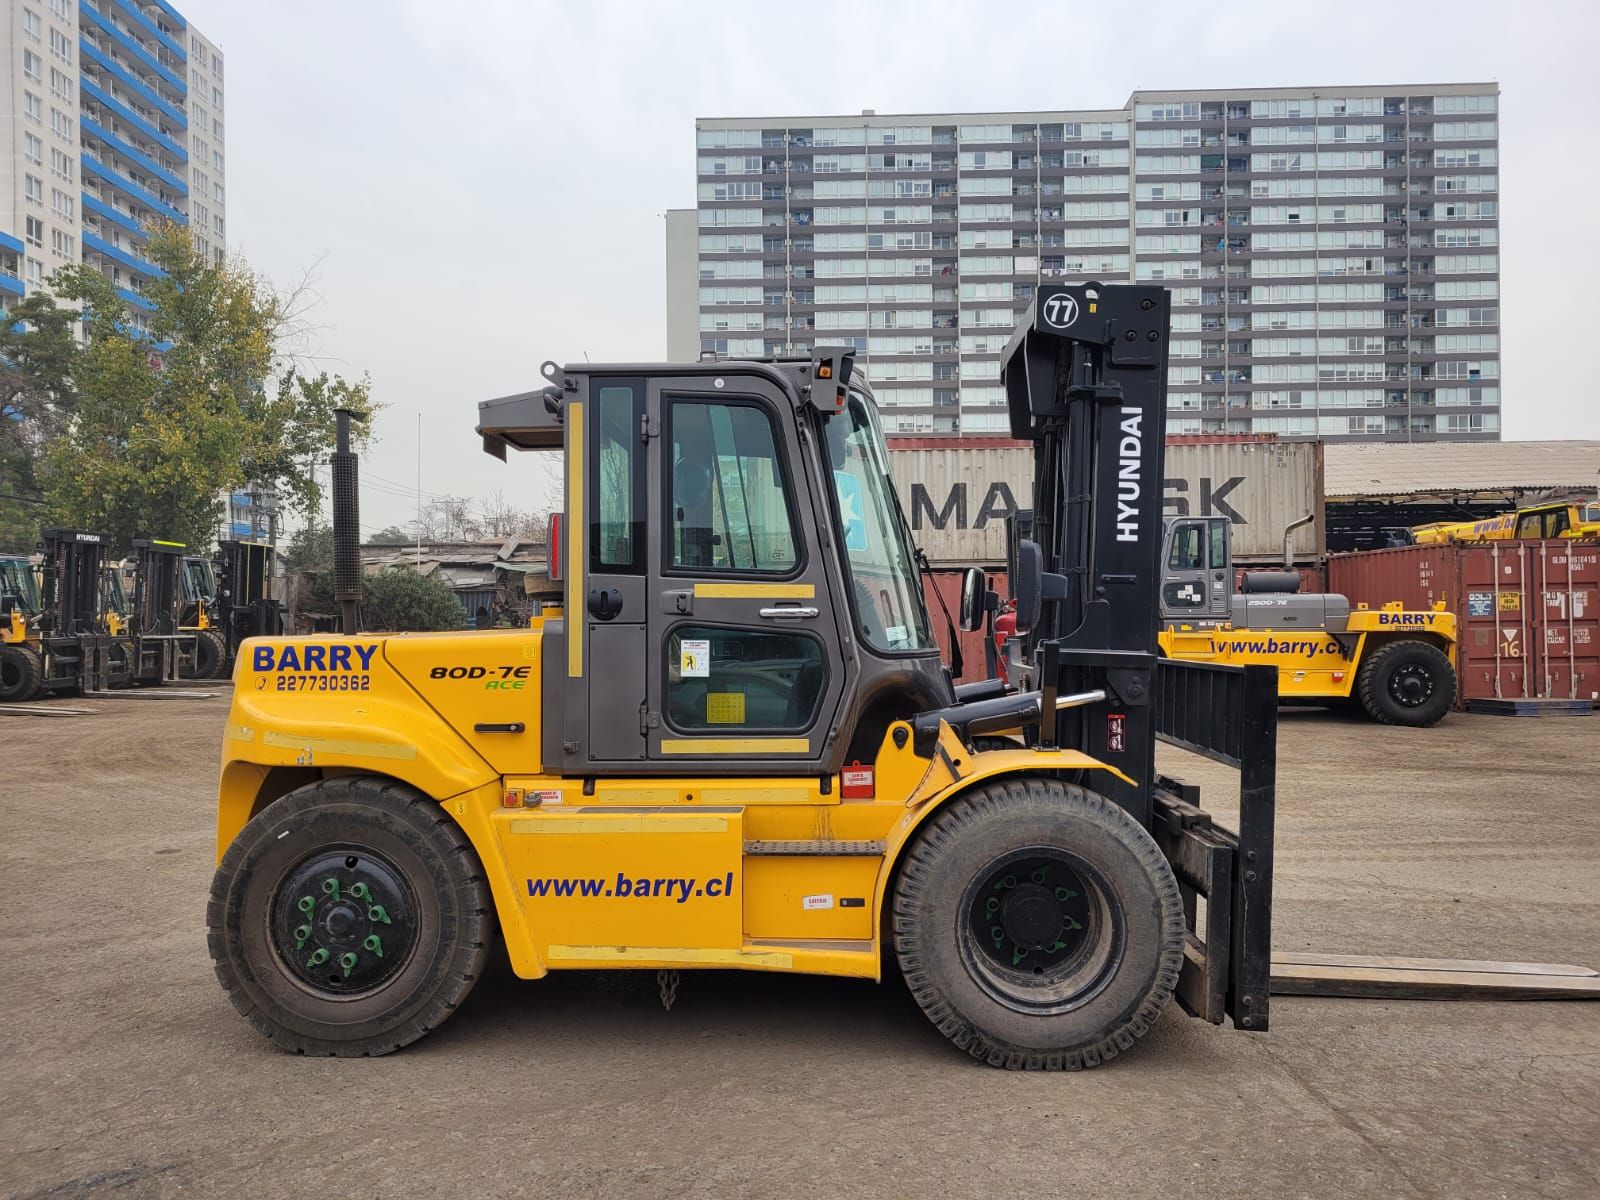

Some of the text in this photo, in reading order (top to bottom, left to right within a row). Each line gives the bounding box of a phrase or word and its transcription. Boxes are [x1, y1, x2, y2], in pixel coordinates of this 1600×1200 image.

[1049, 300, 1074, 322] 77
[1116, 407, 1142, 541] HYUNDAI
[910, 476, 1249, 531] MAK
[1379, 613, 1436, 625] BARRY
[1210, 638, 1342, 658] www.barry.c
[1500, 640, 1520, 658] 16
[253, 645, 378, 672] BARRY
[429, 666, 532, 679] 80D-7E
[277, 675, 370, 691] 227730362
[485, 680, 526, 690] ACE
[526, 872, 734, 904] www.barry.cl
